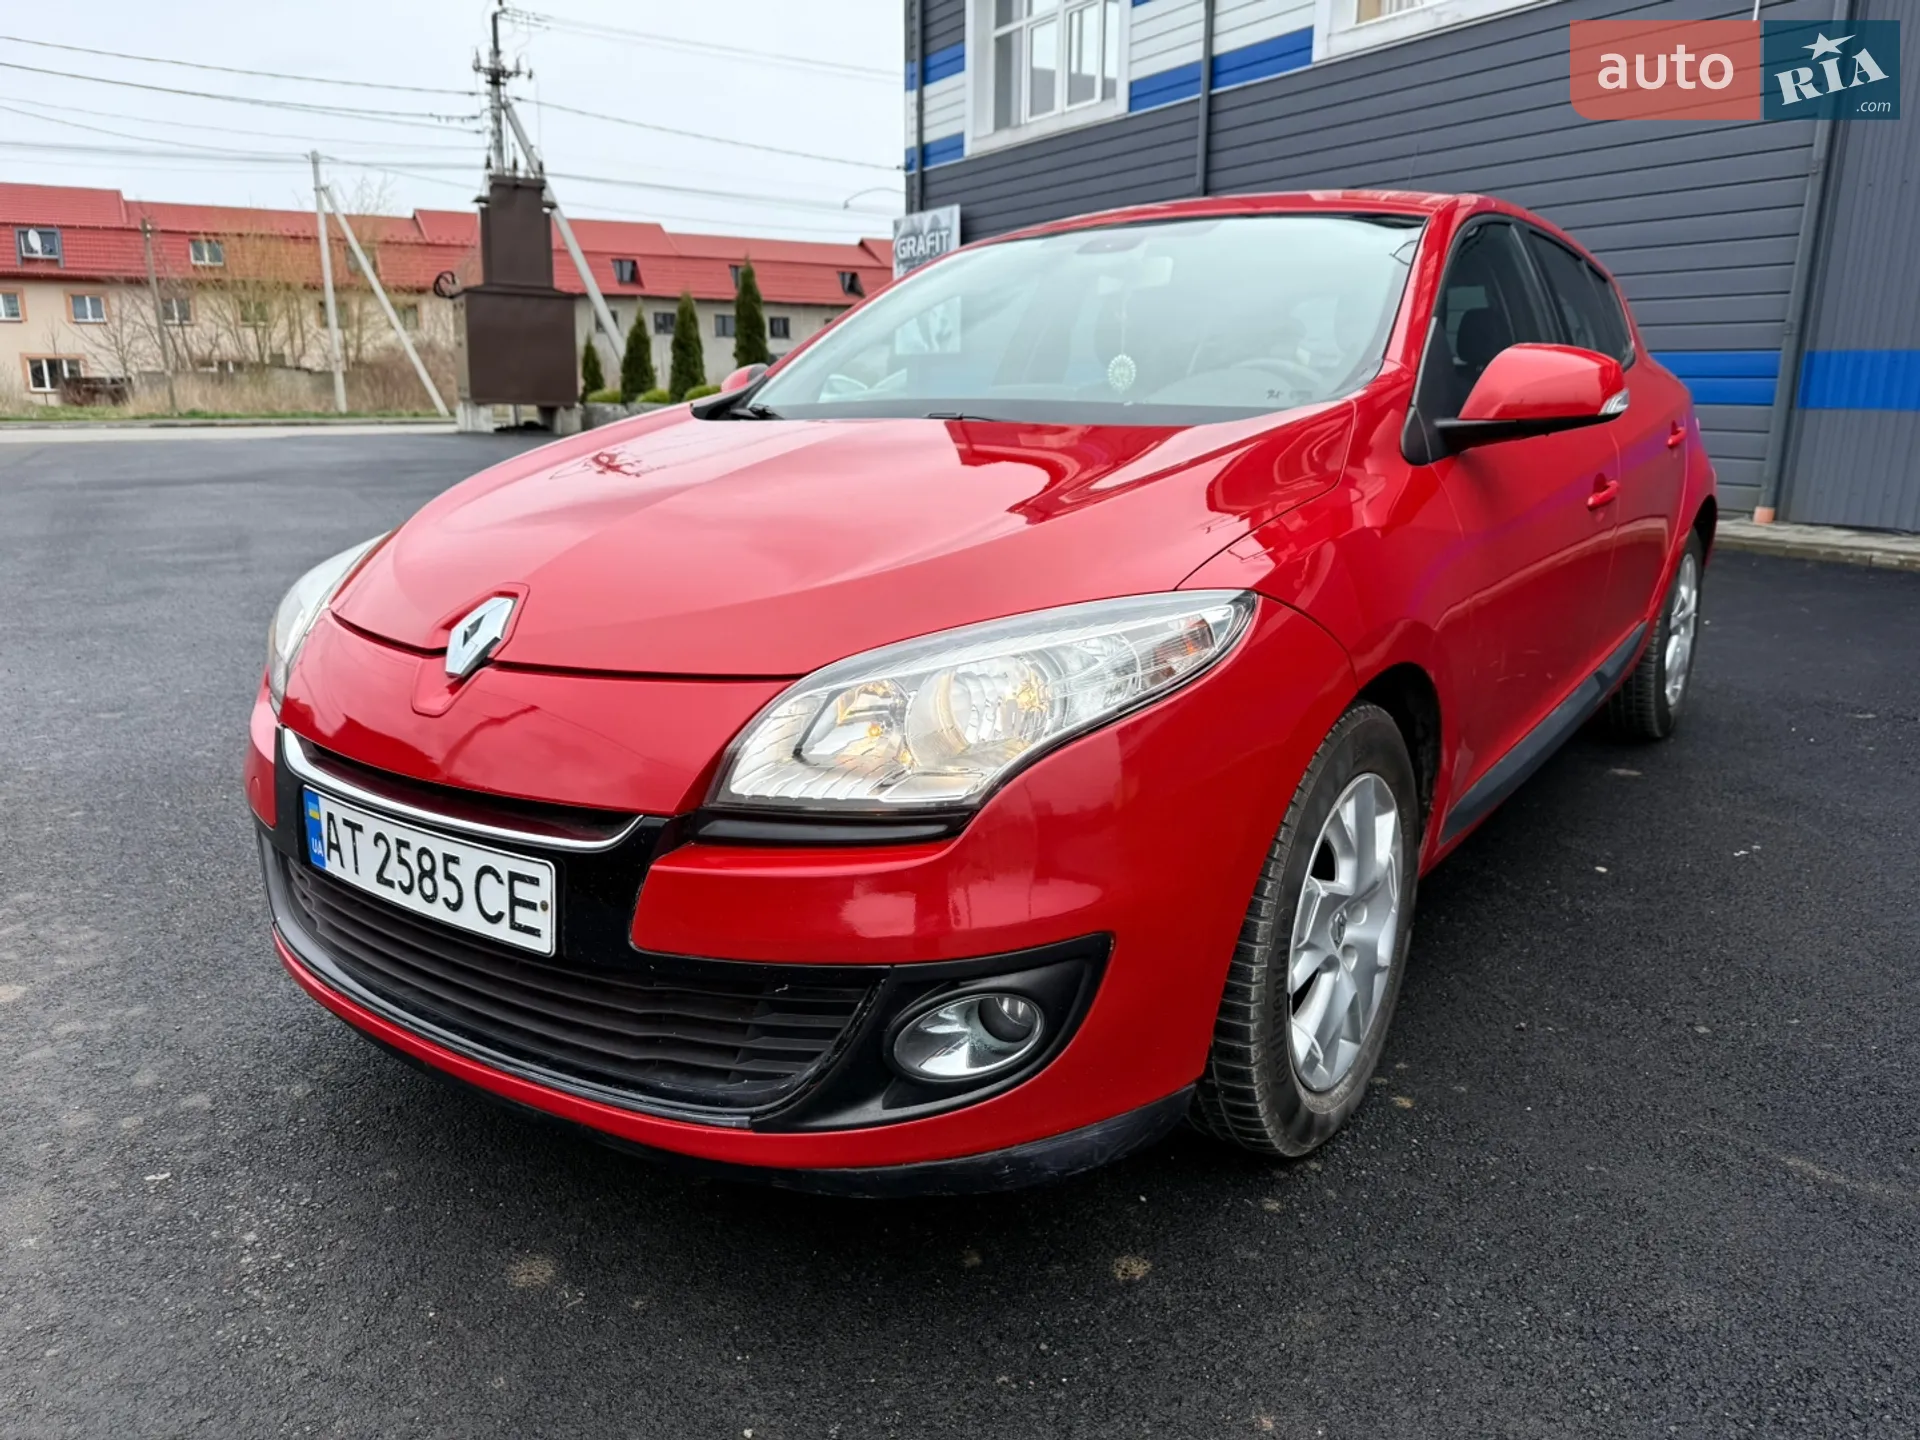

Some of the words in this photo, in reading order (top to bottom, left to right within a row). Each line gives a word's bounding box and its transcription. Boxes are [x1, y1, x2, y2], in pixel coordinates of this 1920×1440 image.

[897, 230, 950, 259] GRAFIT
[311, 837, 324, 858] UA
[326, 811, 364, 876] AT
[373, 831, 463, 913] 2585
[474, 864, 542, 938] CE
